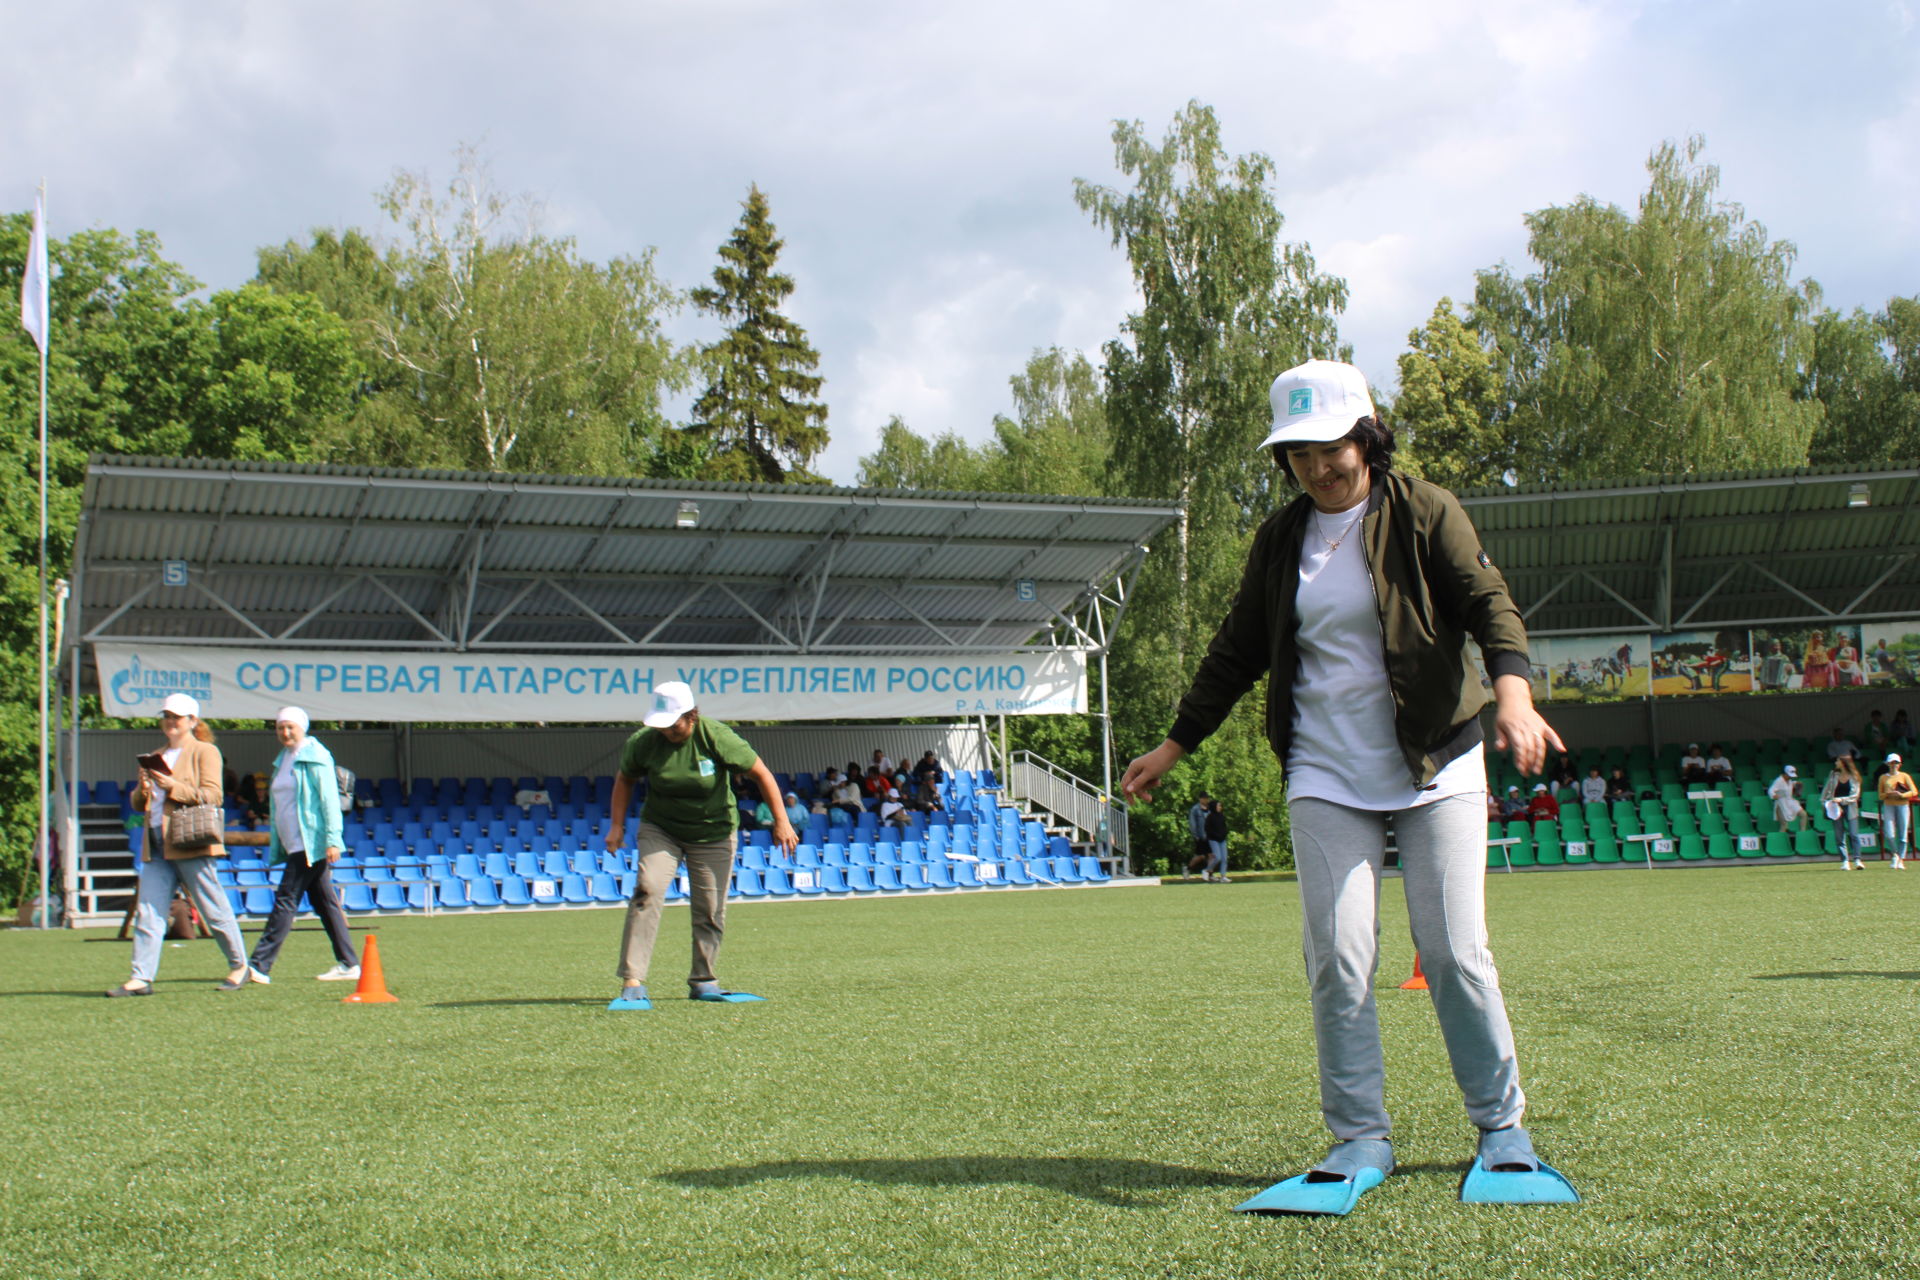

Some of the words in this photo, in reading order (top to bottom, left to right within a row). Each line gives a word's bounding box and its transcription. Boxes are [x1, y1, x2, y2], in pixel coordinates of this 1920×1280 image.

[167, 563, 182, 582] 5
[1020, 582, 1033, 599] 5
[236, 661, 441, 693] СОГРЕВАЯ
[453, 665, 654, 695] ТАТАРСТАН
[678, 665, 876, 694] УКРЕПЛЯЕМ
[887, 664, 1026, 693] РОССИЮ
[1744, 839, 1757, 850] 30
[1860, 837, 1871, 846] 31
[1570, 845, 1584, 855] 28
[1657, 842, 1670, 853] 29
